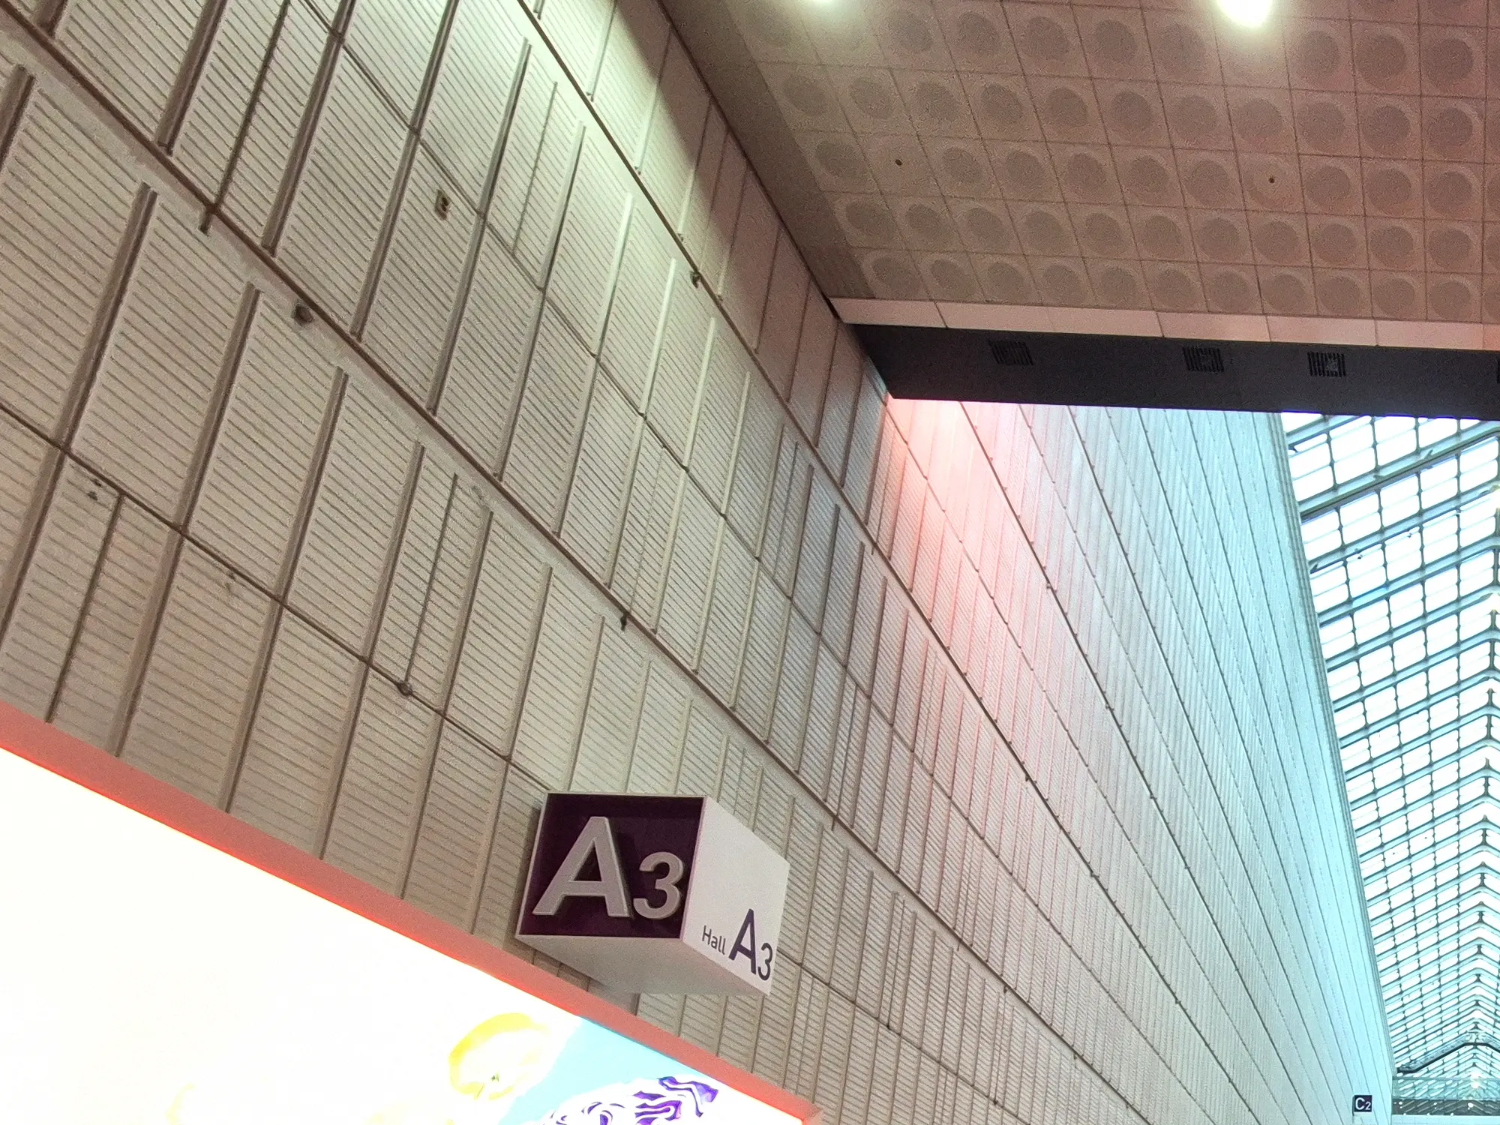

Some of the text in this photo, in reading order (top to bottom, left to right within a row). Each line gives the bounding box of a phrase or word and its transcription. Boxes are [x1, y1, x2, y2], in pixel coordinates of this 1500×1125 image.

[531, 815, 686, 920] A3
[701, 908, 773, 981] Hall A3
[1355, 1097, 1371, 1110] C2
